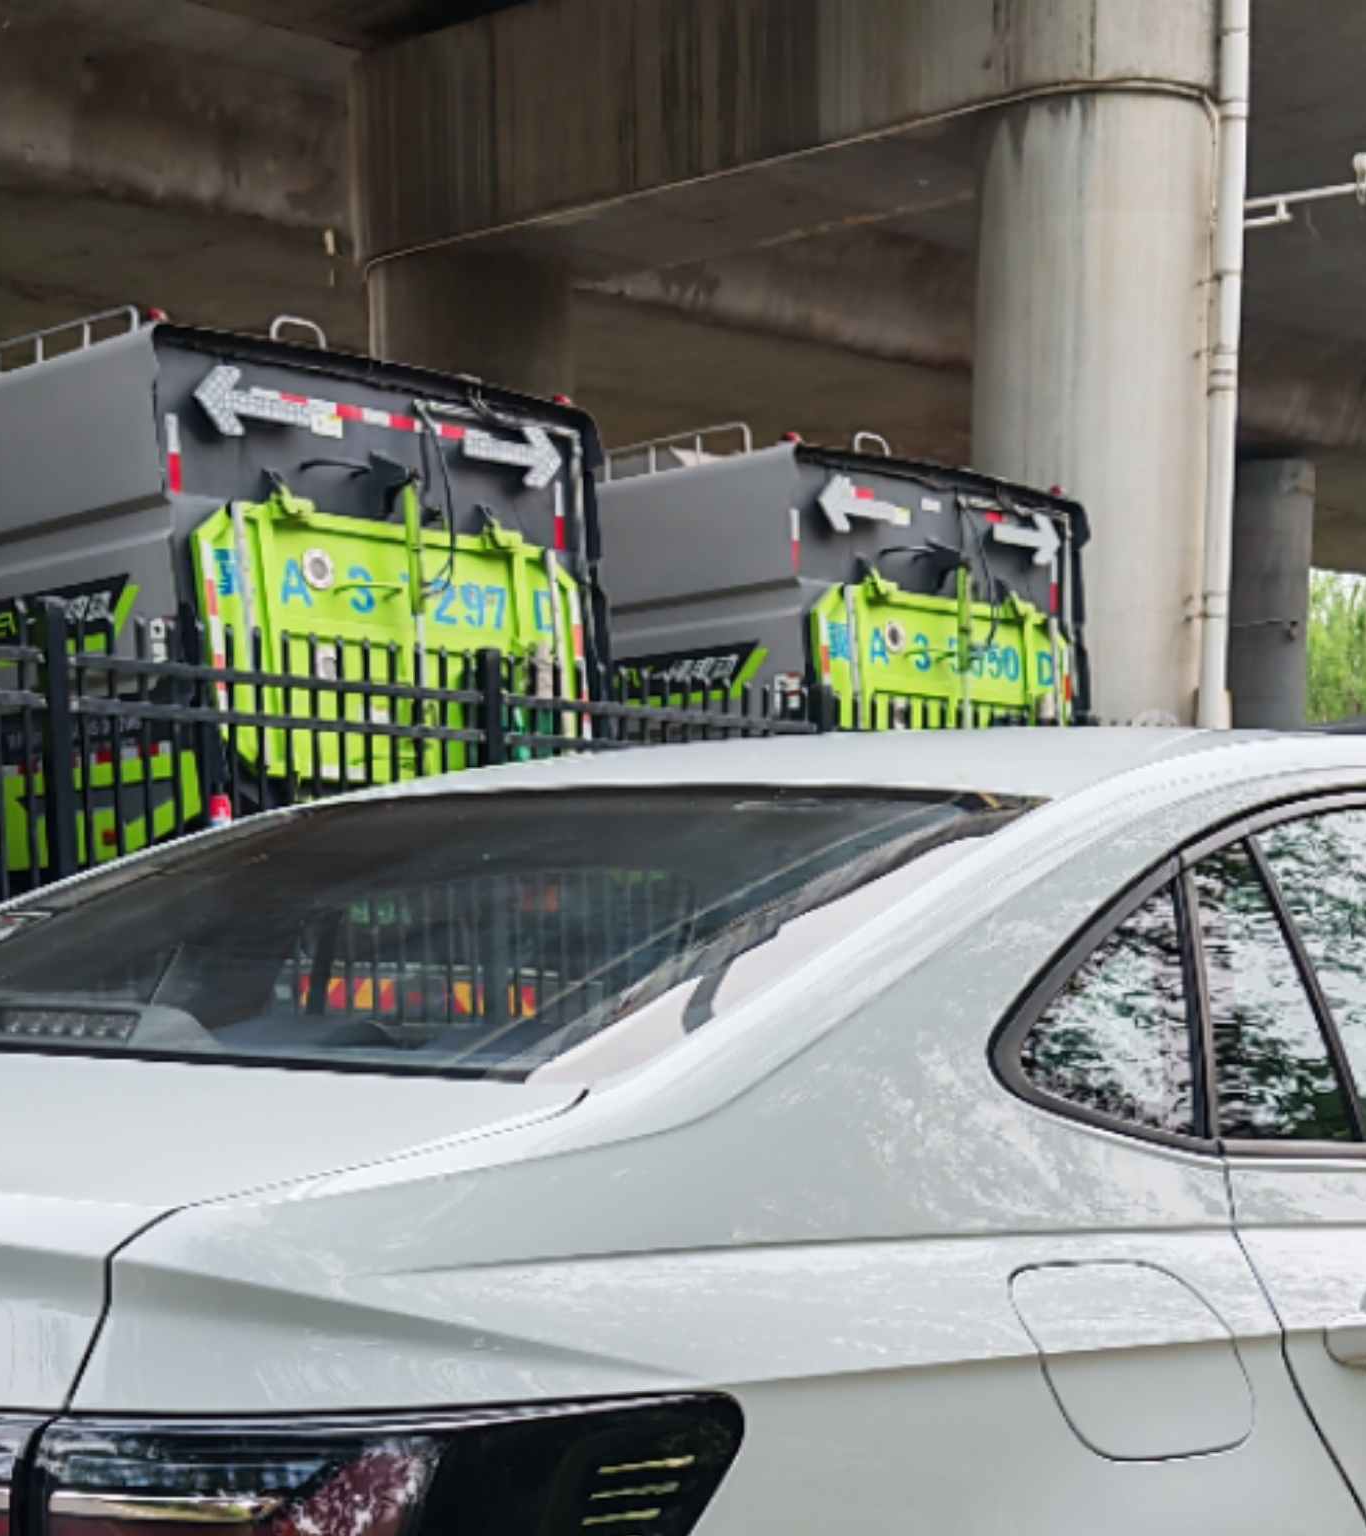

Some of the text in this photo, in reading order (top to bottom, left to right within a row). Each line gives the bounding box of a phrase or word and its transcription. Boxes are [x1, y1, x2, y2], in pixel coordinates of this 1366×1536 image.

[282, 558, 314, 608] A
[347, 565, 376, 614] 3
[870, 627, 890, 665] A
[914, 633, 931, 671] 3
